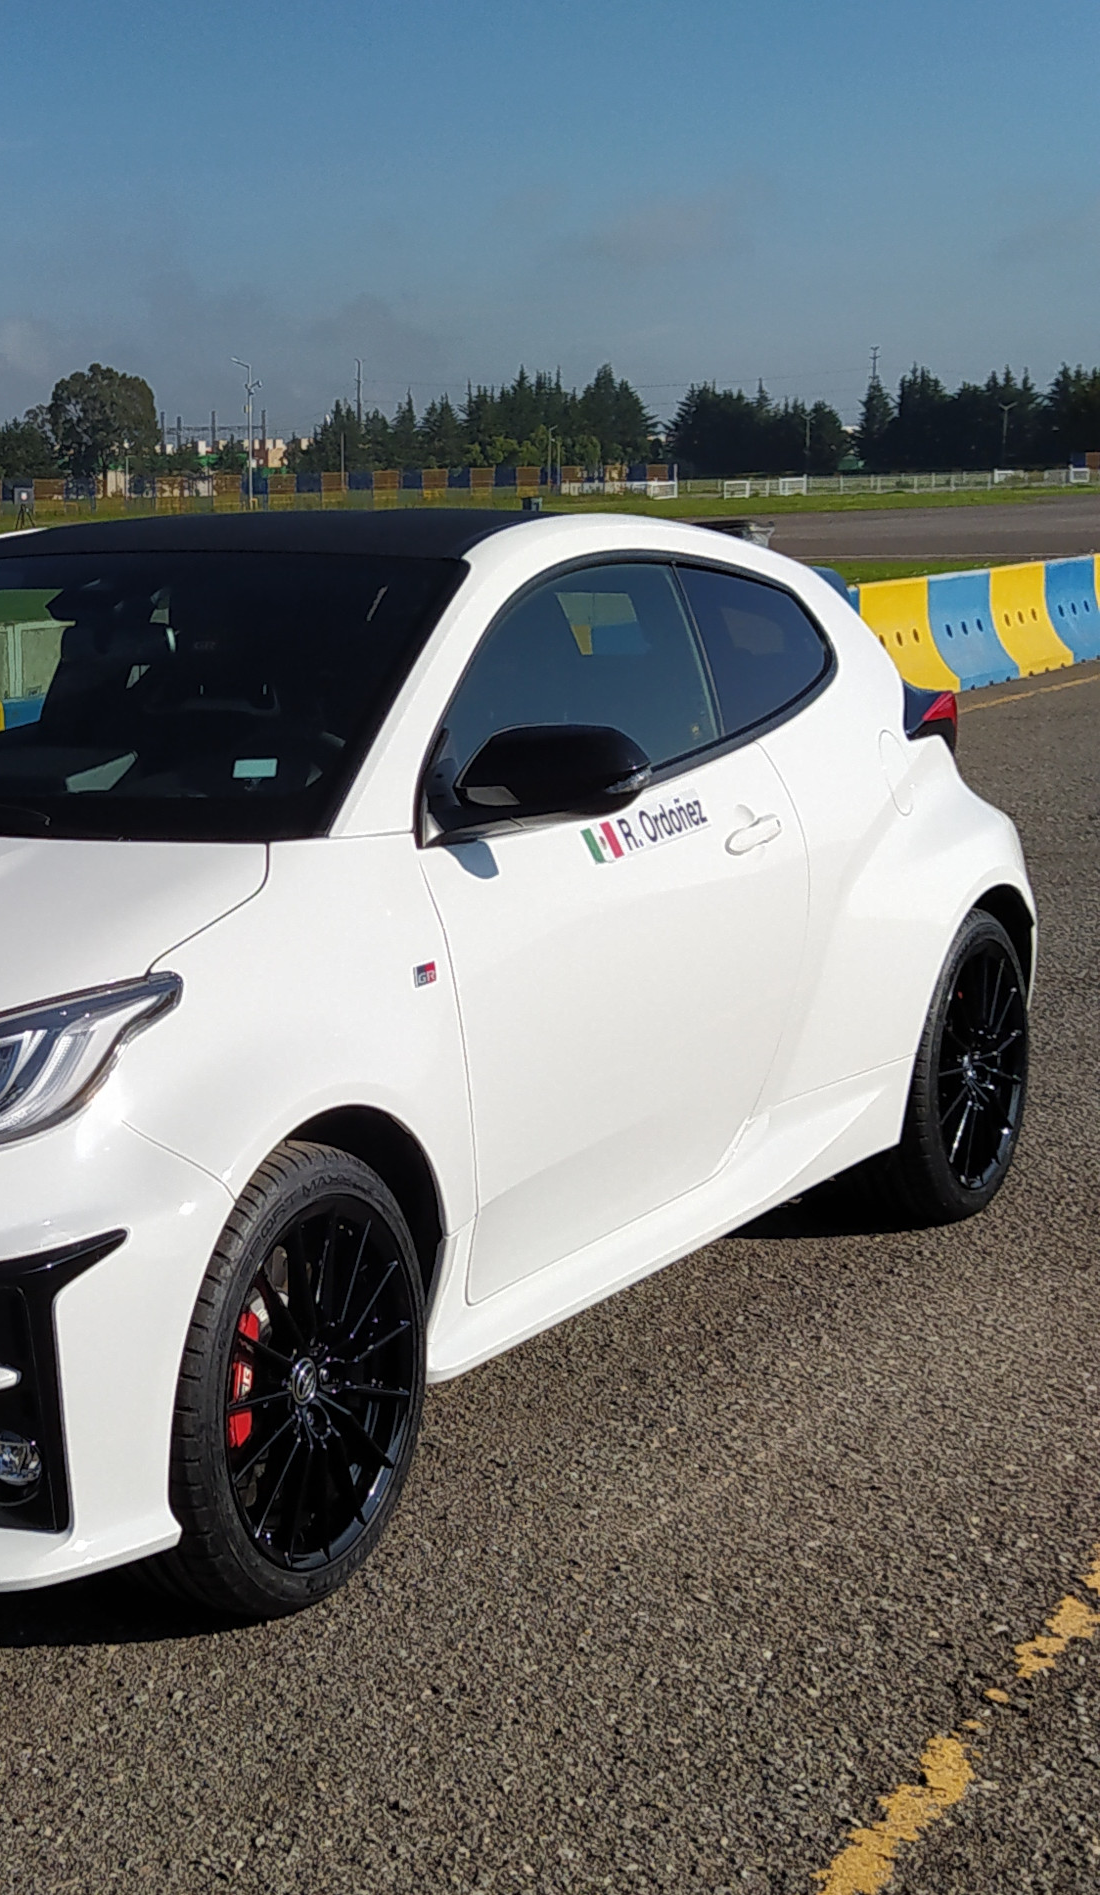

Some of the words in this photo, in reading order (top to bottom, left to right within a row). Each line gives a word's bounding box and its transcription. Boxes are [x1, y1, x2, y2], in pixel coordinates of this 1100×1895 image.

[617, 818, 644, 851] R.
[639, 798, 708, 842] Ordoñez
[417, 968, 436, 985] GR
